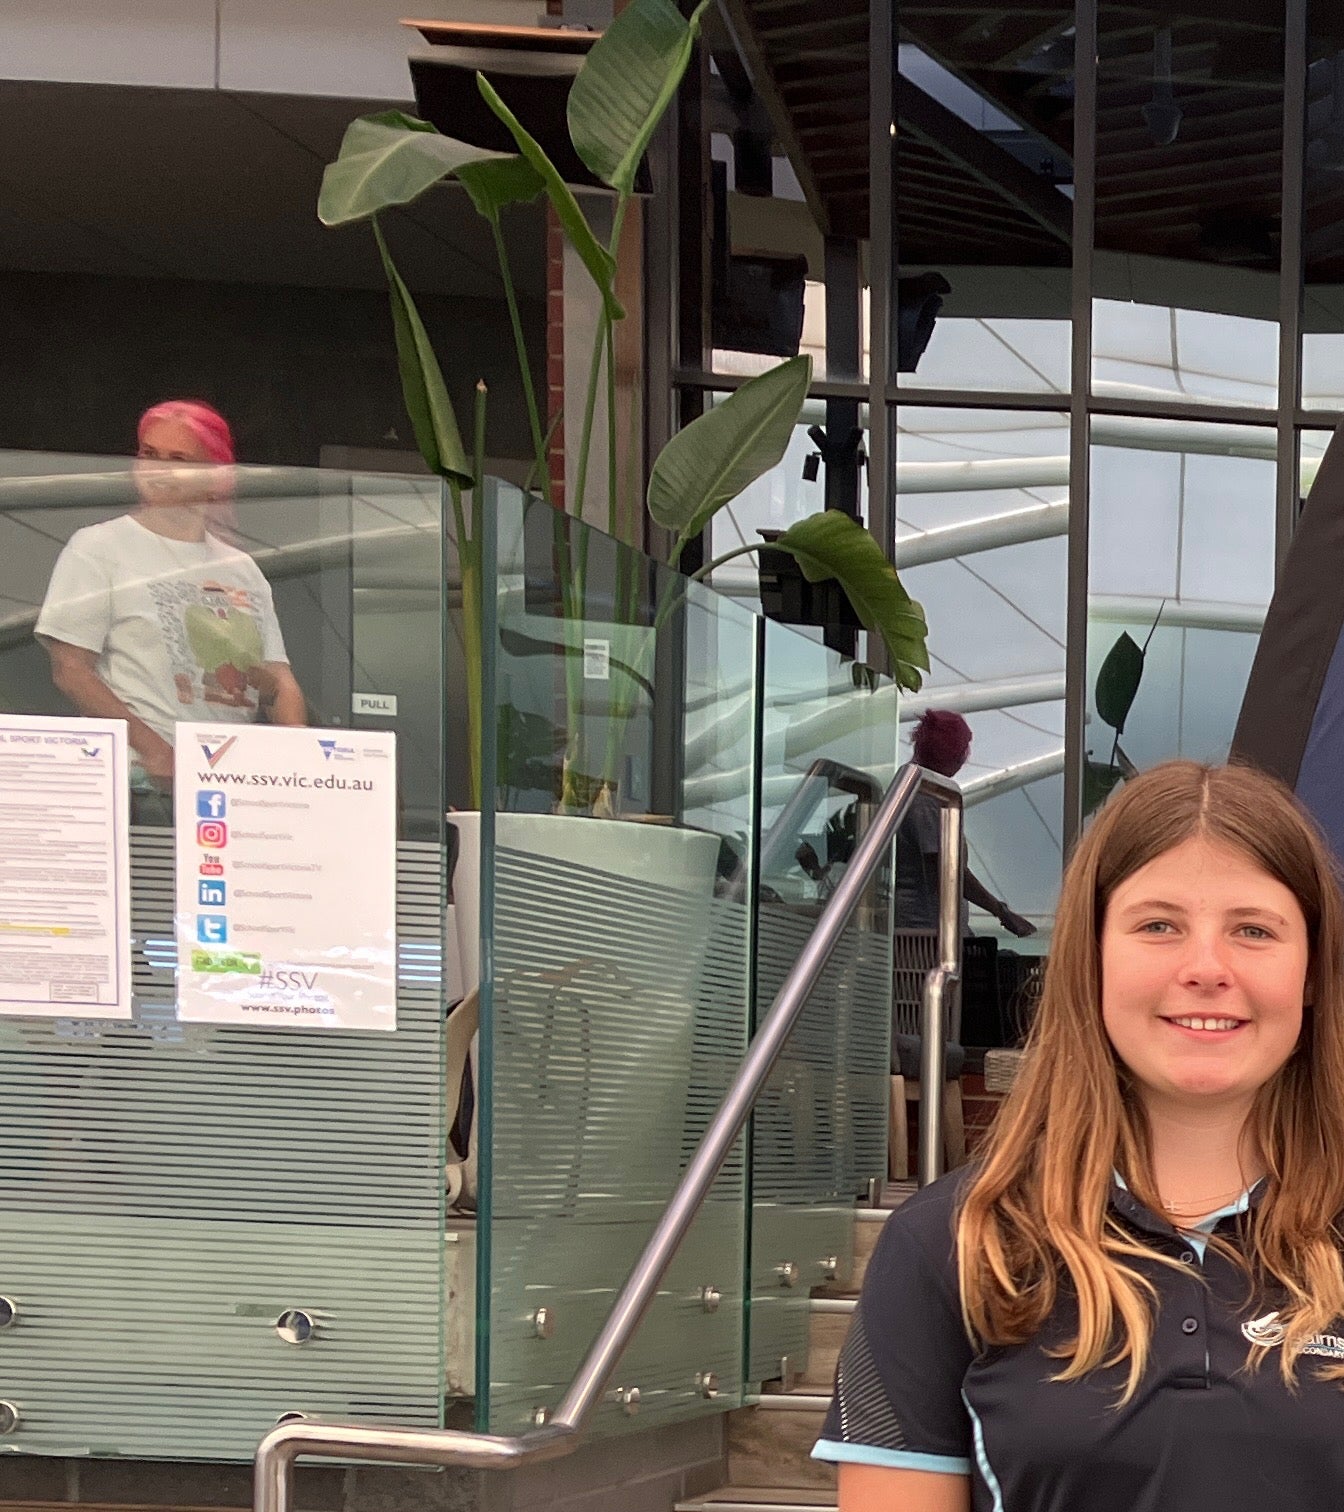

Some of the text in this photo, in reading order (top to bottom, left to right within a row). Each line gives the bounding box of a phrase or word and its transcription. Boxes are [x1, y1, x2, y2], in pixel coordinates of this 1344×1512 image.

[360, 699, 390, 710] PULL
[197, 770, 374, 791] www.ssv.vic.edu.au
[259, 970, 319, 990] #SSV
[241, 1002, 336, 1015] www.ssv.photos
